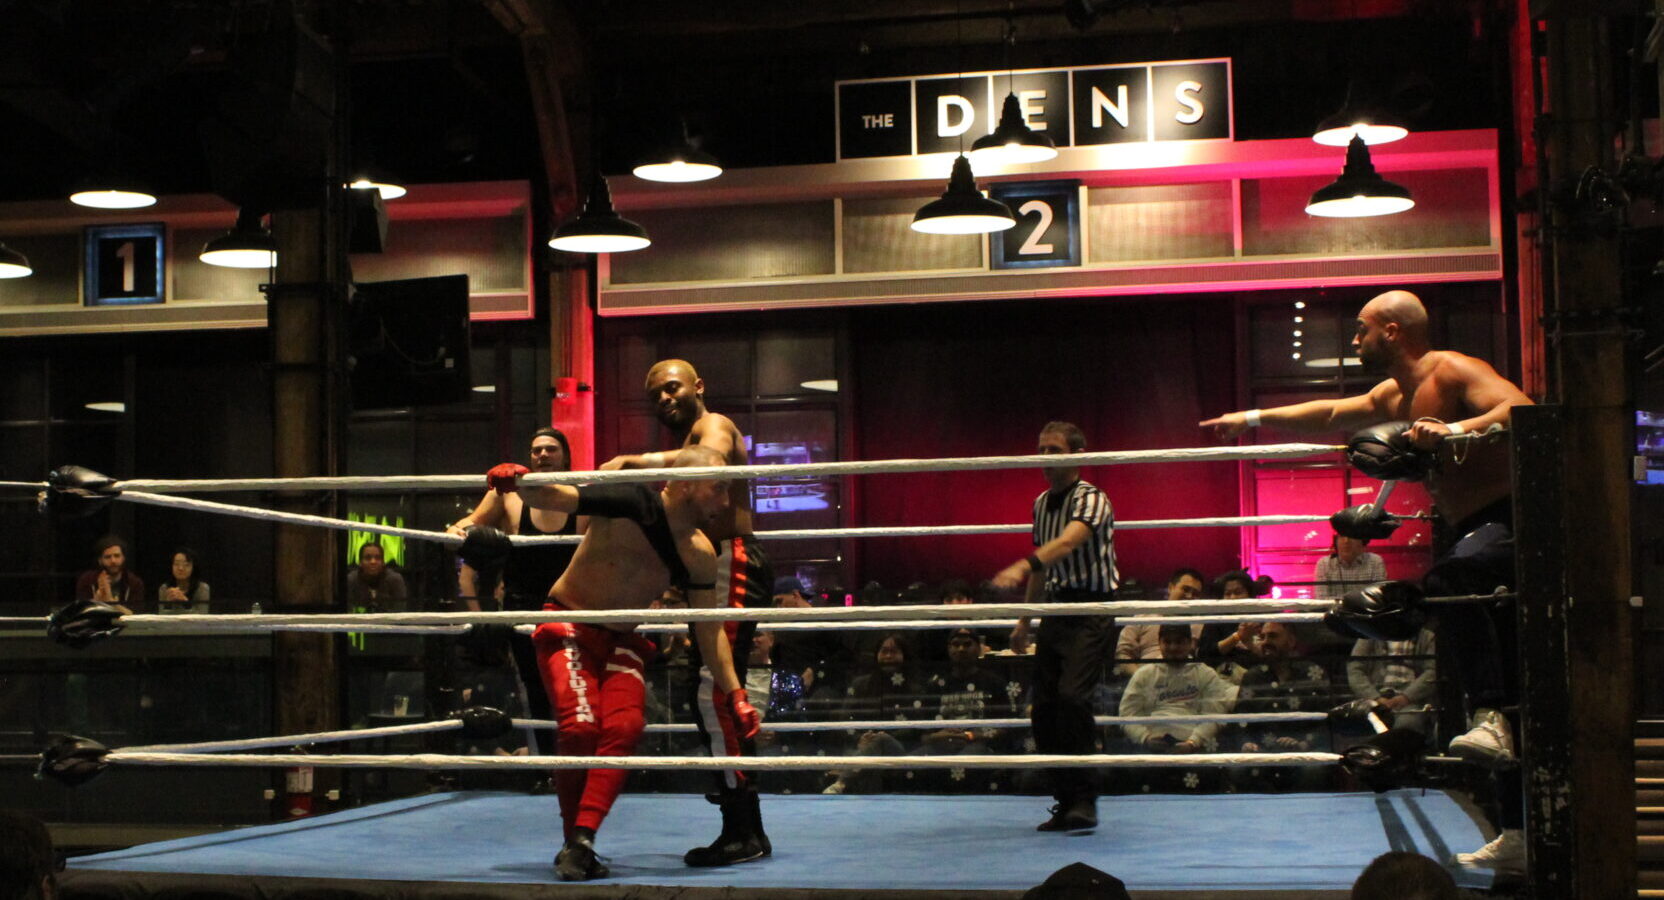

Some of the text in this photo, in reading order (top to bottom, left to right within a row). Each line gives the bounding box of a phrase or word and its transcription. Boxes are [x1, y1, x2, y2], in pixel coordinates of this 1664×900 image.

[862, 114, 894, 129] THE
[1018, 200, 1054, 255] 2
[116, 242, 135, 292] 1
